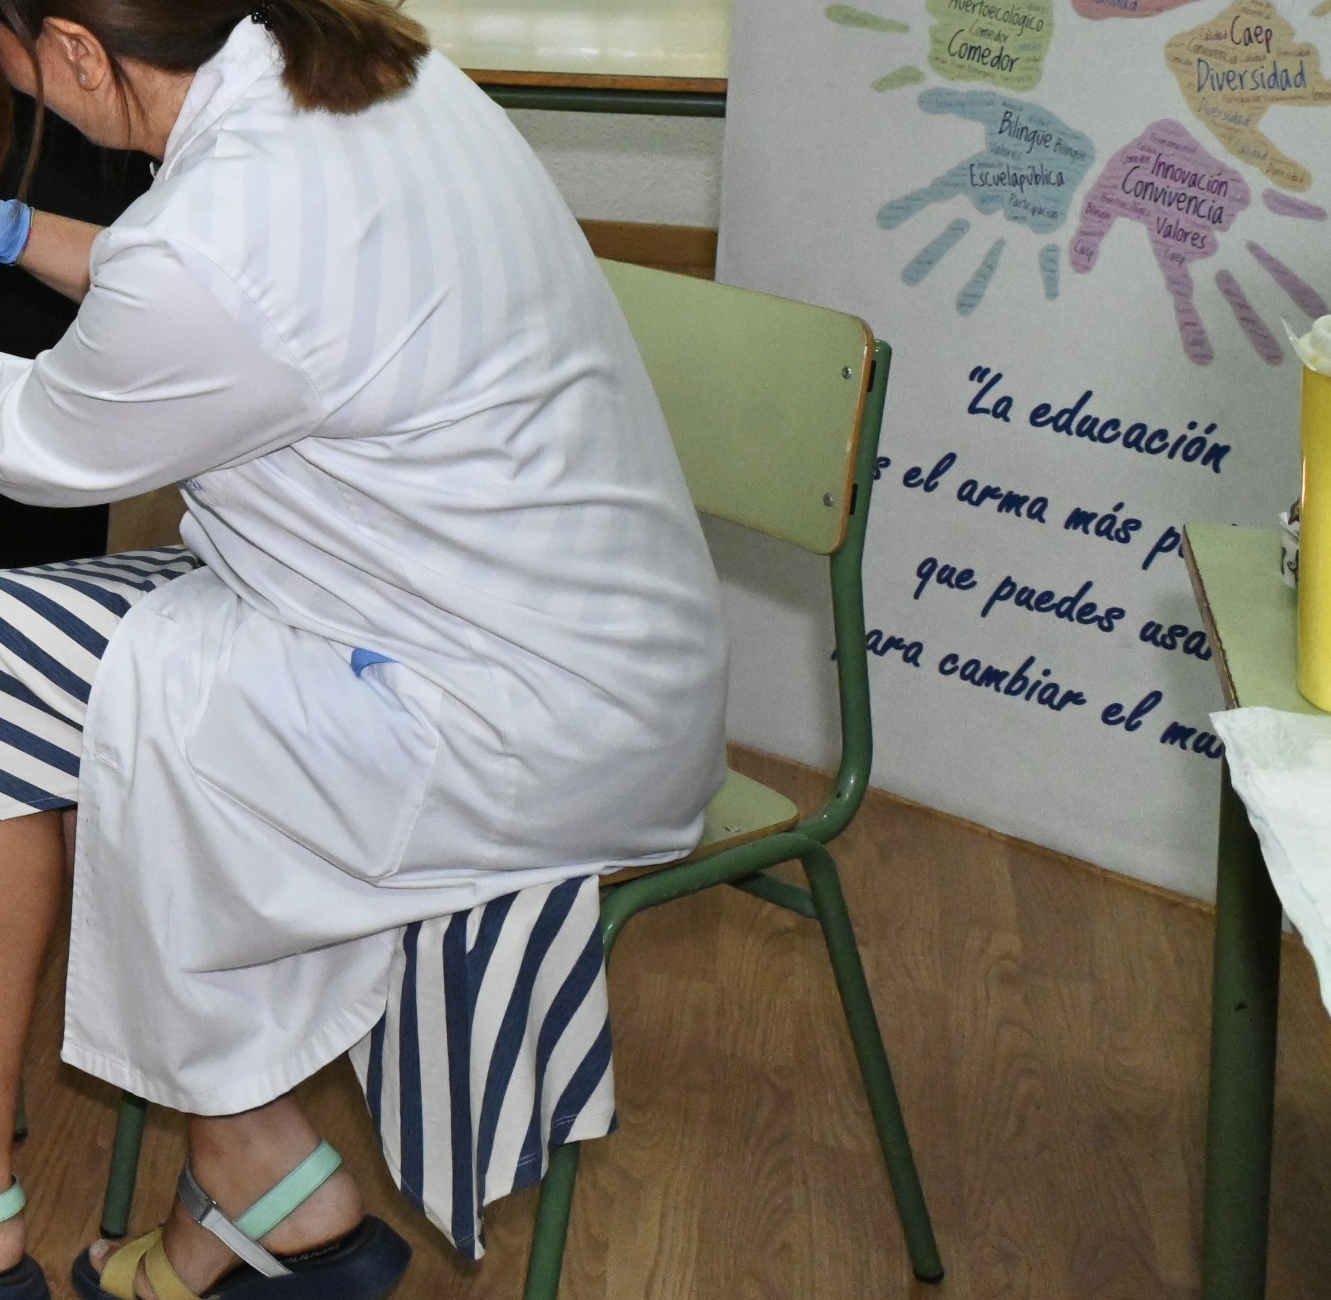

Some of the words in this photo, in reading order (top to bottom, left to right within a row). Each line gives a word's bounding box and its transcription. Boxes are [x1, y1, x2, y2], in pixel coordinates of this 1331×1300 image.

[947, 28, 1020, 72] Comedor
[1231, 15, 1273, 53] Caep
[1196, 58, 1307, 92] Diversidad
[998, 110, 1053, 153] Bilingüe
[969, 163, 1065, 194] Escuelapública
[1122, 165, 1225, 225] Convivencia
[1150, 152, 1229, 197] Innovación
[1156, 215, 1208, 249] Valores
[1029, 390, 1231, 473] educación
[902, 452, 957, 493] el
[1064, 501, 1142, 544] más
[913, 556, 978, 600] que
[980, 576, 1126, 633] puedes
[1140, 619, 1212, 661] usa
[831, 628, 924, 667] ara
[938, 652, 1087, 712] cambiar
[1101, 690, 1163, 732] el
[1159, 720, 1226, 759] mu
